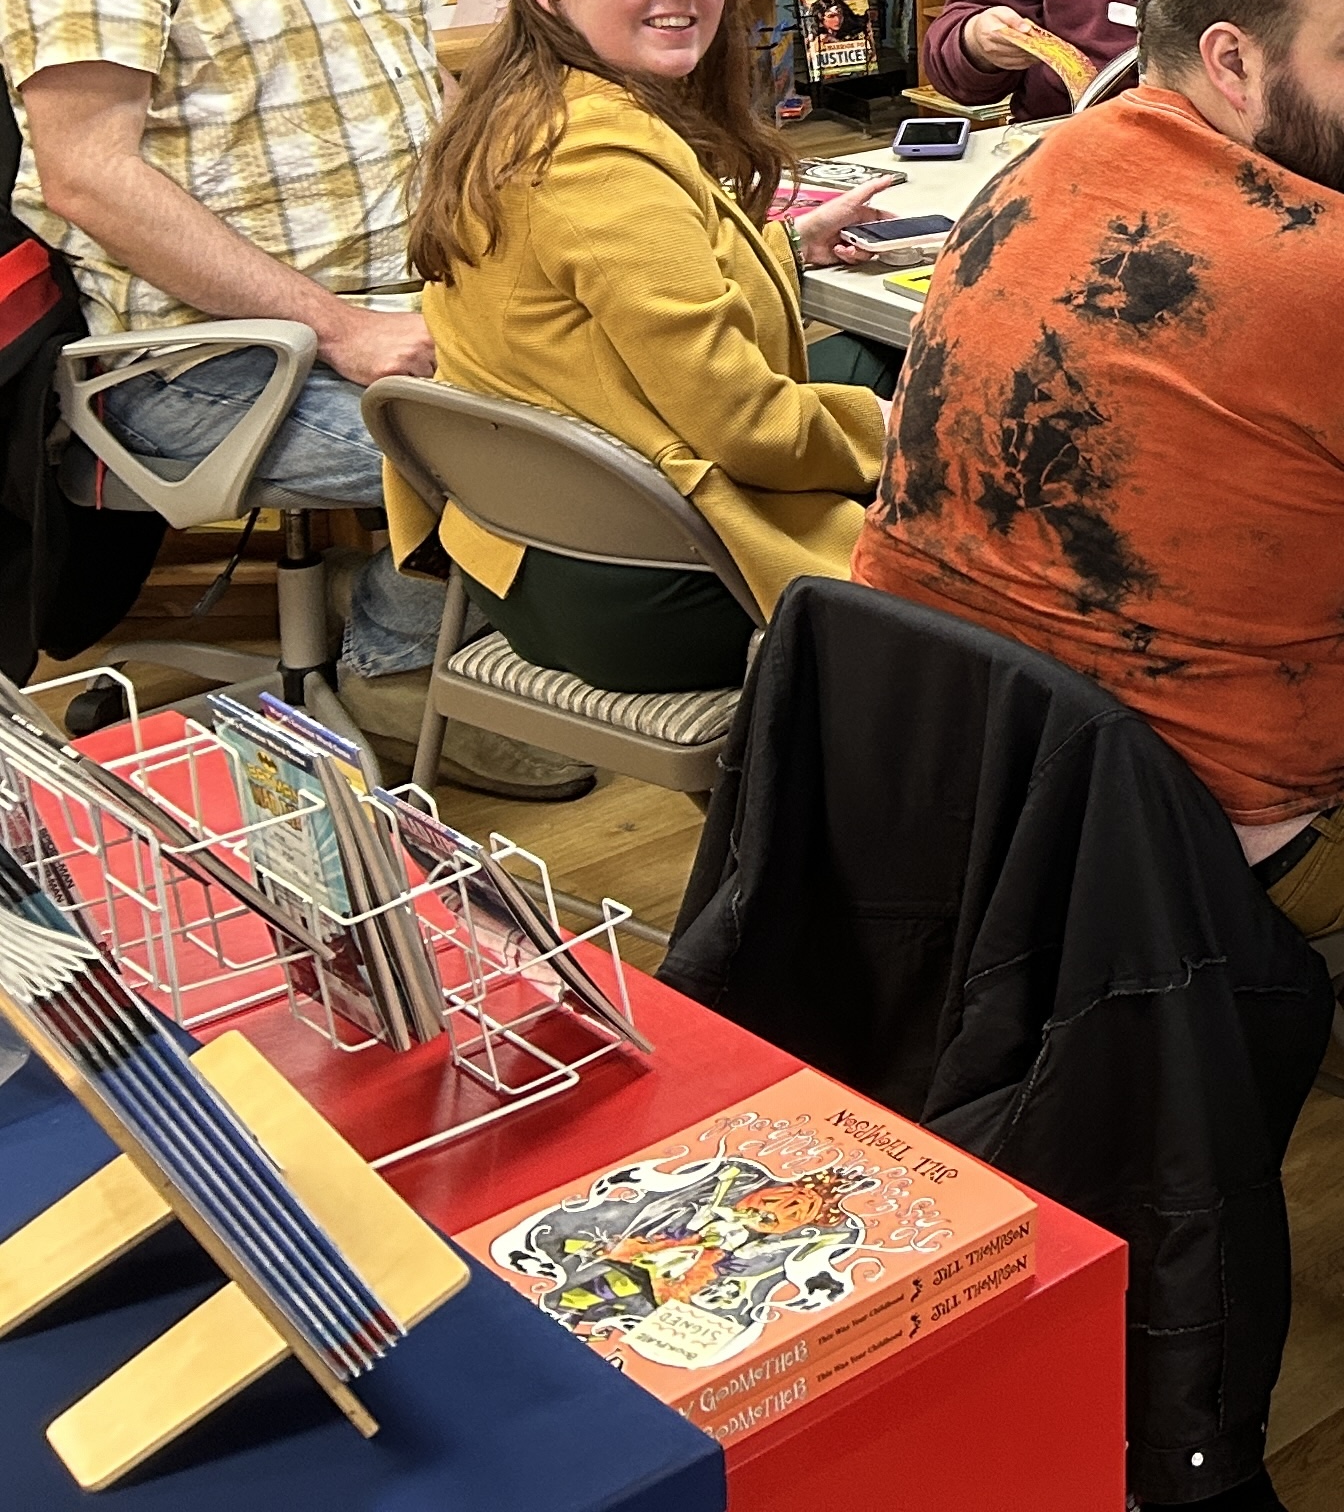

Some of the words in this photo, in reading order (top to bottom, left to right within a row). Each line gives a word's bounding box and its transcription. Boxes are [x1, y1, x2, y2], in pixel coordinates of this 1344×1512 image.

[825, 1108, 913, 1163] THOMPSON
[912, 1155, 958, 1185] JILL
[933, 1263, 964, 1285] JILL
[965, 1221, 1031, 1264] THOMPSON
[930, 1296, 962, 1321] JILL
[963, 1255, 1028, 1299] THOMPSON
[659, 1312, 718, 1340] SIGNED
[817, 1331, 836, 1344] This
[836, 1324, 851, 1337] Was
[851, 1317, 868, 1331] Your
[869, 1294, 905, 1321] Childhood
[700, 1339, 810, 1411] GODMOTHER
[816, 1366, 834, 1380] This
[834, 1360, 850, 1373] Was
[850, 1352, 867, 1367] Your
[867, 1330, 904, 1356] Childhood
